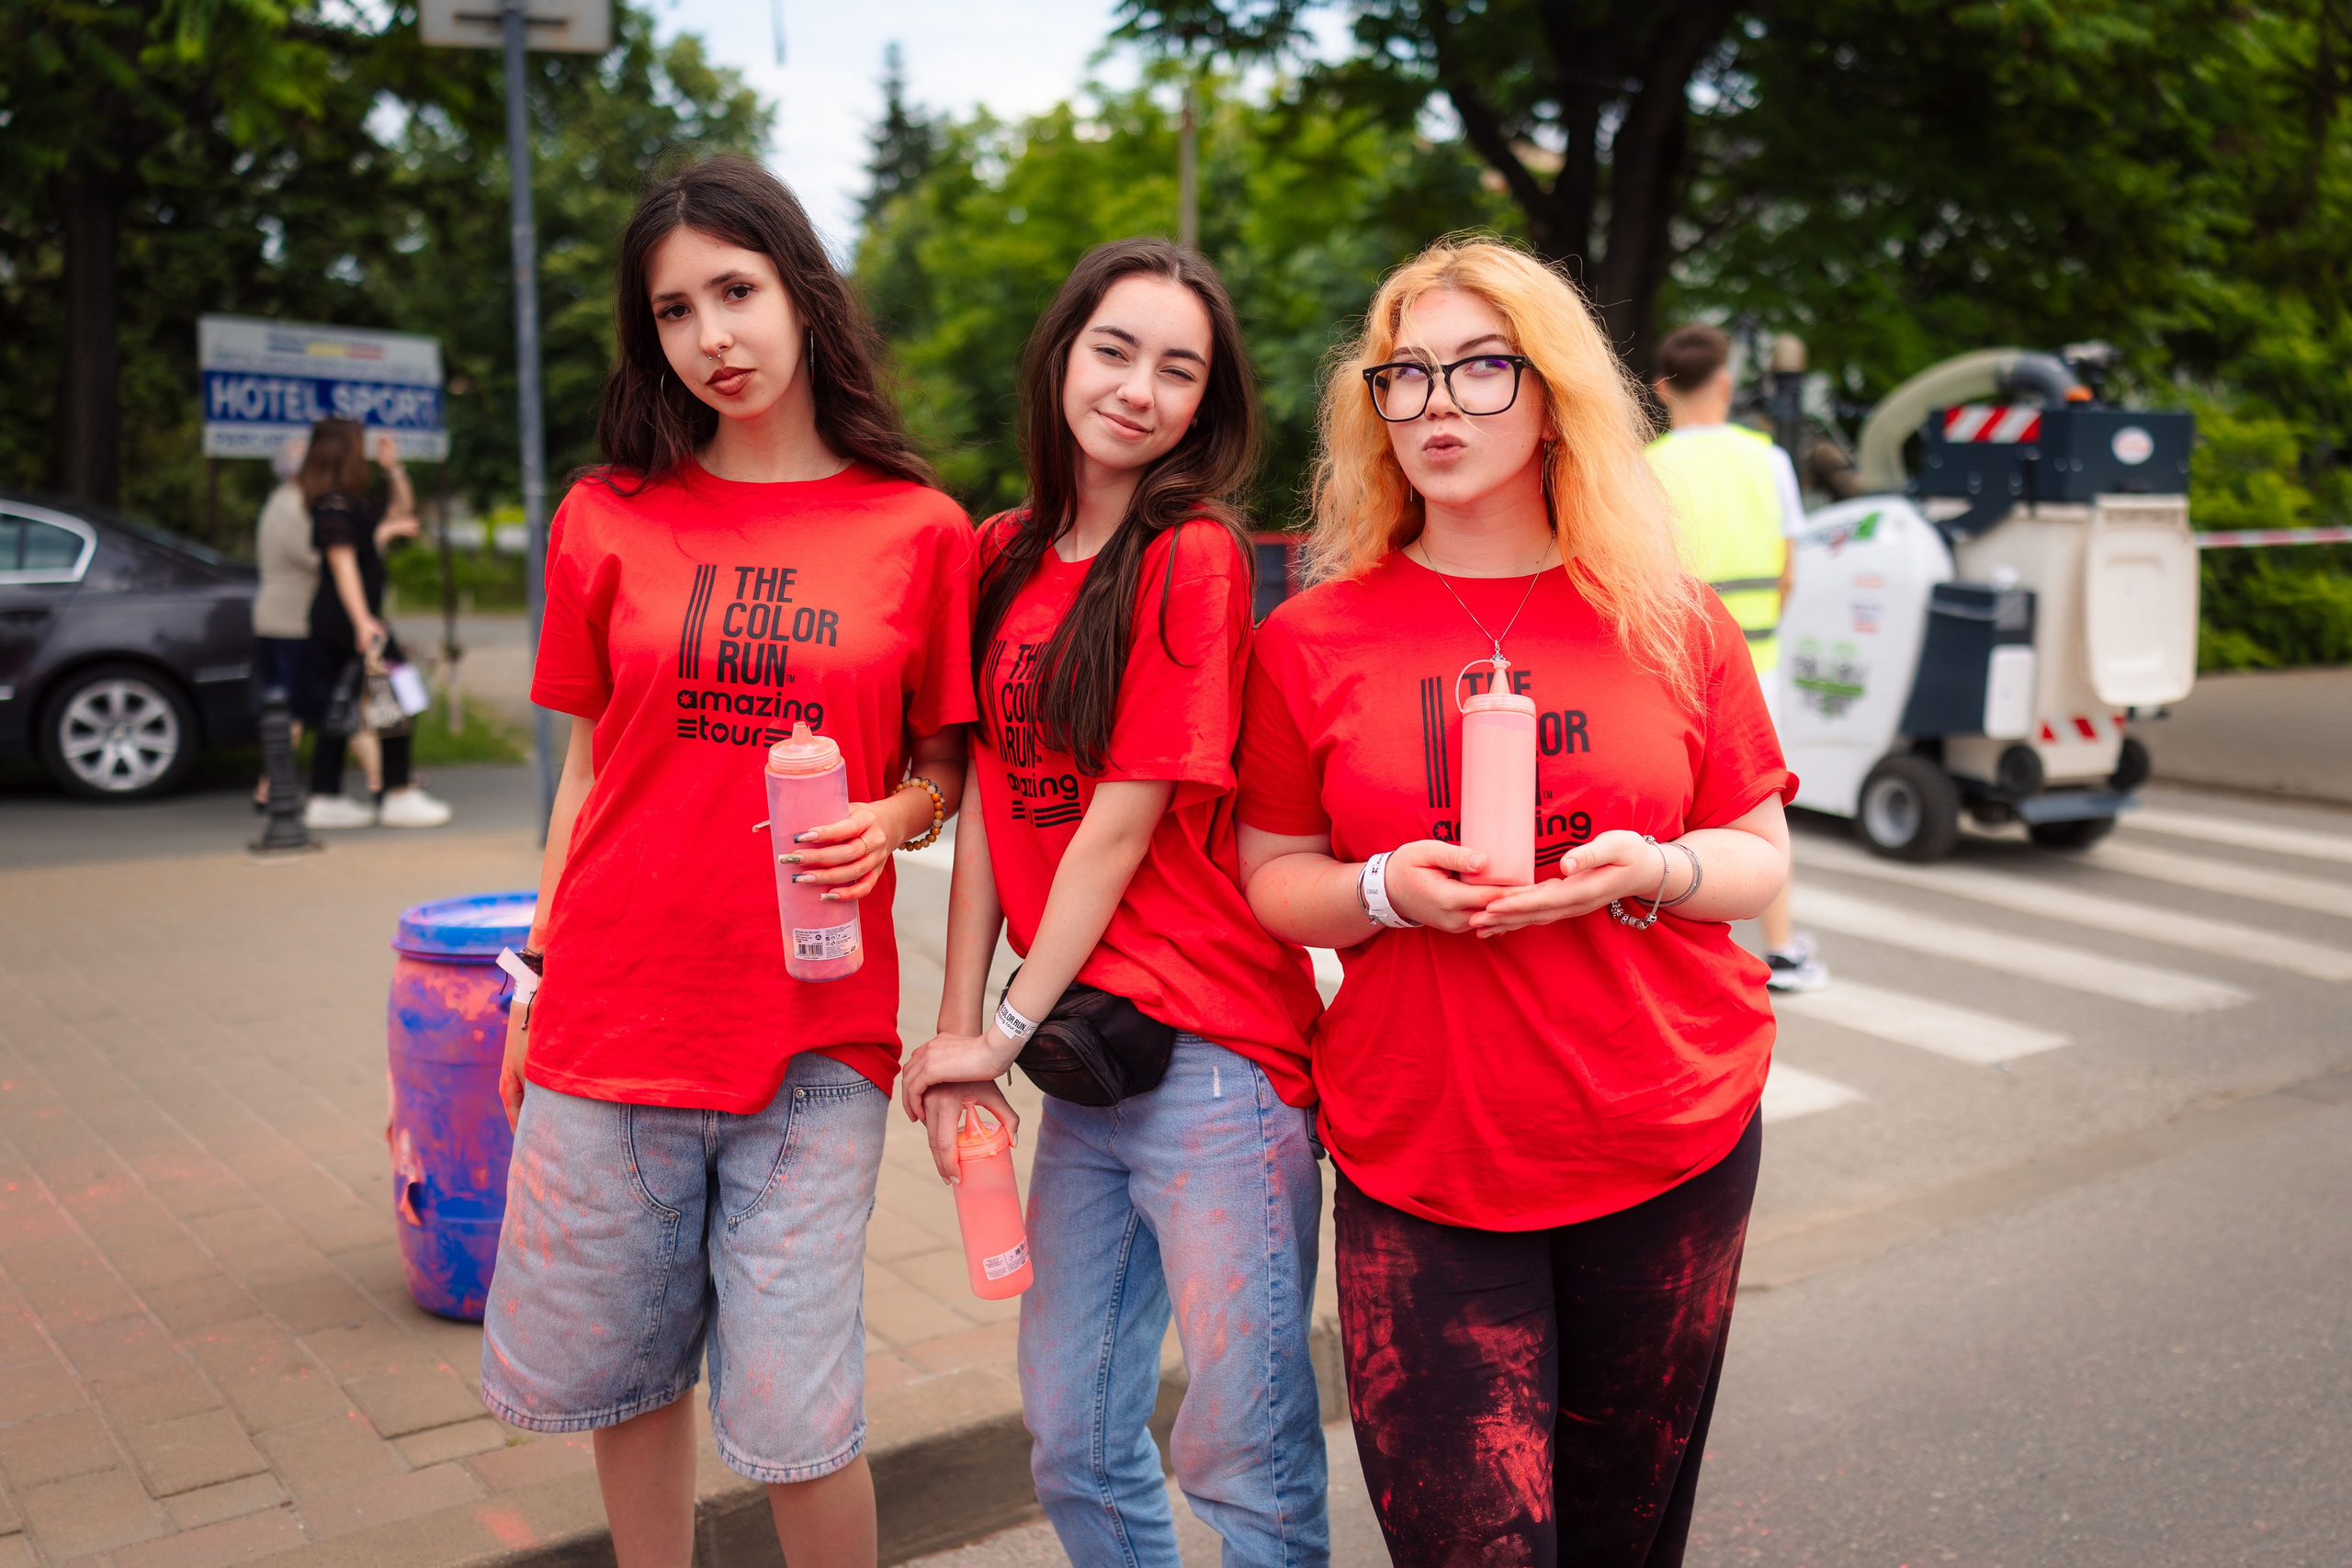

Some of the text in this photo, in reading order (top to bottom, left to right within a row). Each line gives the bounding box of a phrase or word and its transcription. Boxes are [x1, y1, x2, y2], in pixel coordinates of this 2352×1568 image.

[210, 375, 436, 426] HOTEL SPORT
[735, 566, 797, 604] THE
[722, 602, 840, 647] COLOR
[716, 639, 788, 688] RUN
[676, 689, 824, 731] amazing
[698, 714, 763, 747] tour
[1004, 726, 1035, 769] RUN
[1432, 810, 1592, 842] aing
